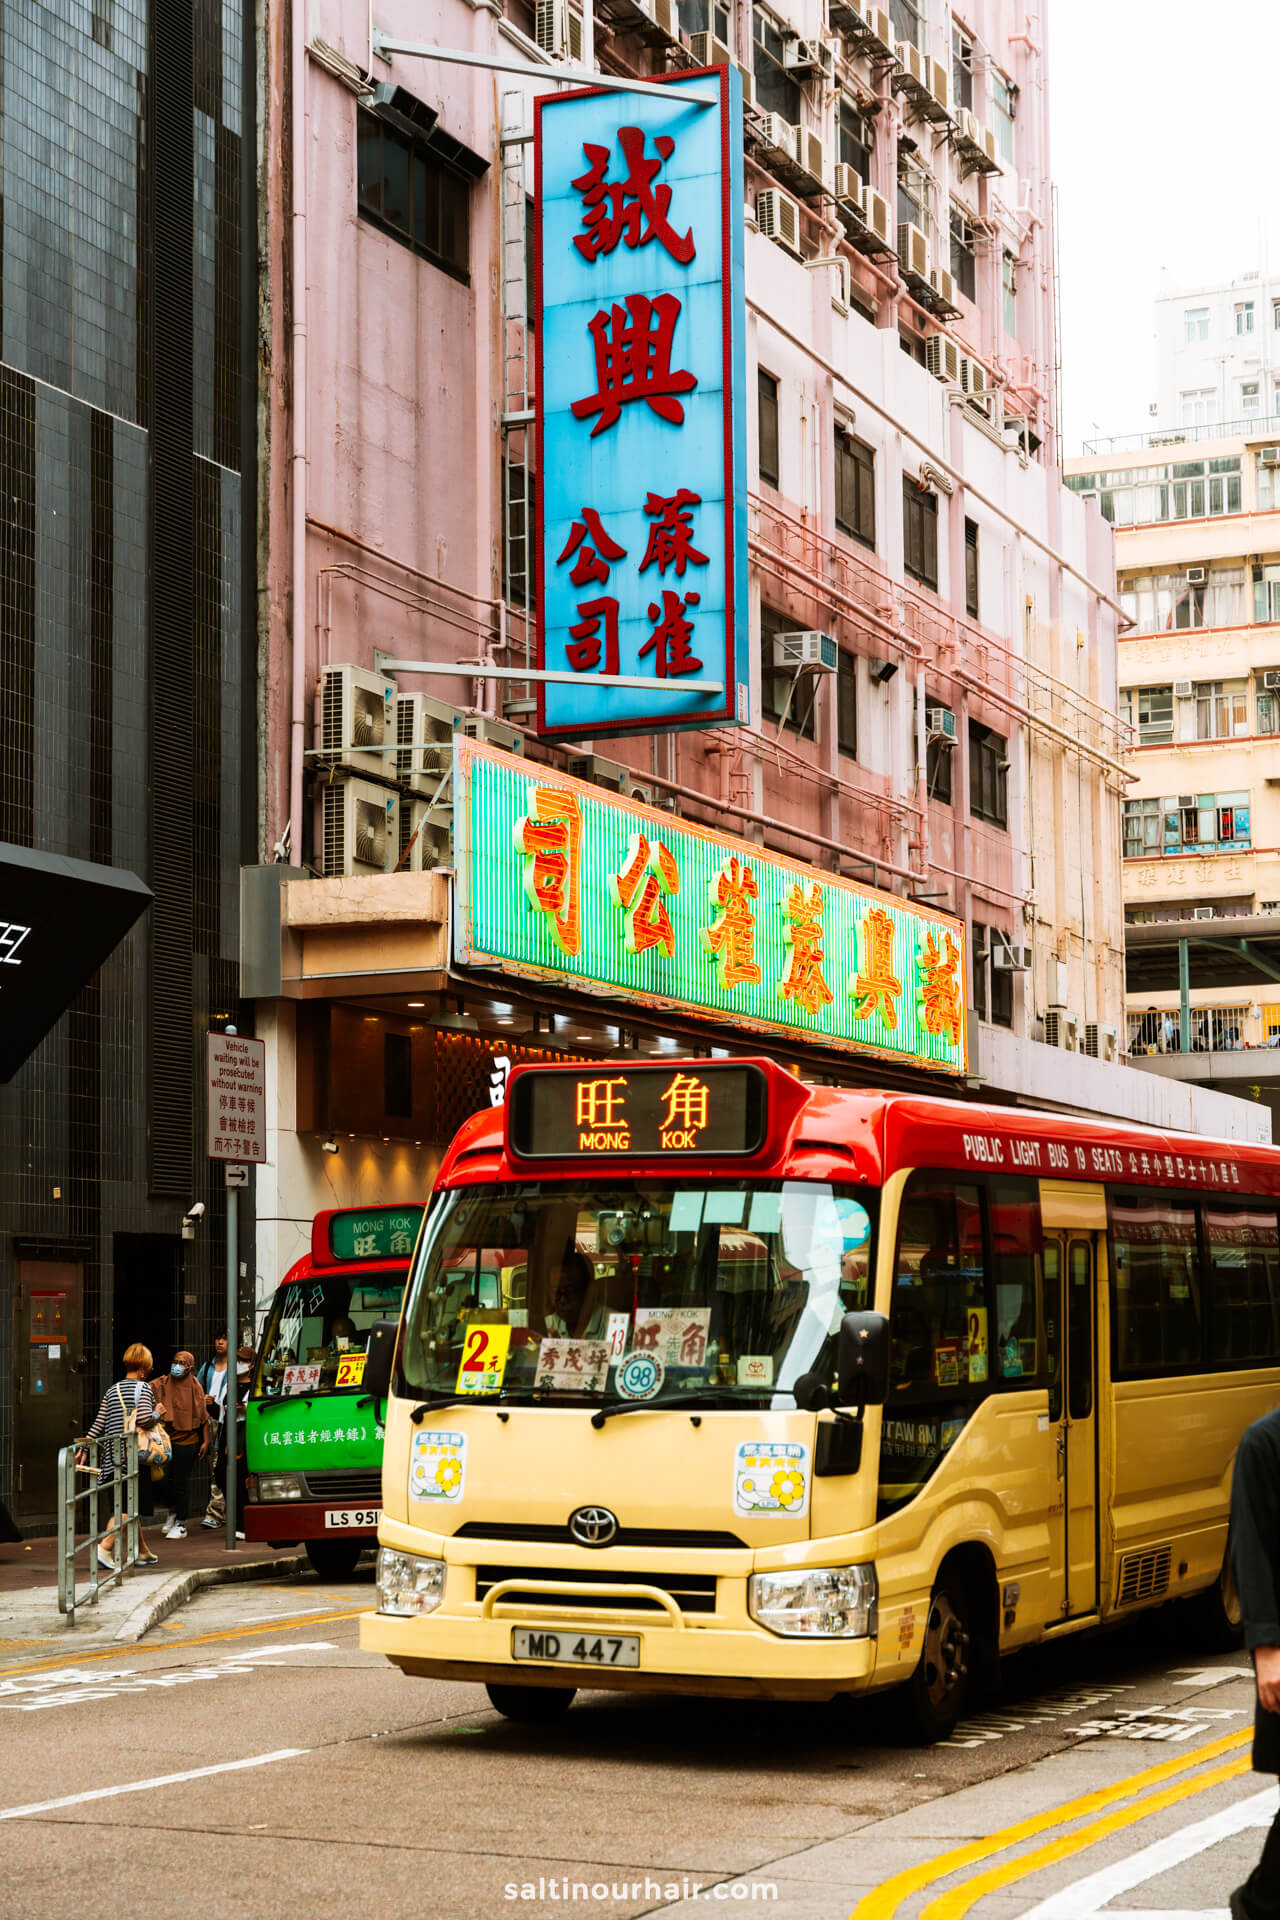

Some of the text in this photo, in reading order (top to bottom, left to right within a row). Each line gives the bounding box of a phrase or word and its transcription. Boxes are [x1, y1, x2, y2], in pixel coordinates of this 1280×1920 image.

[570, 126, 697, 438] 誠興
[556, 507, 628, 677] 公司
[225, 1039, 249, 1054] Vehicle
[214, 1053, 260, 1068] waiting will be
[219, 1066, 255, 1081] prosecuted
[211, 1078, 263, 1096] without warning
[576, 1072, 710, 1130] 旺角
[214, 1137, 261, 1156] 而不予警告
[579, 1129, 697, 1151] MONG KOK
[962, 1134, 1004, 1163] PUBLIC
[1009, 1140, 1042, 1167] LIGHT
[1048, 1143, 1069, 1169] BUS
[1074, 1147, 1087, 1171] 19
[1092, 1148, 1124, 1173] SEATS
[352, 1218, 412, 1233] MONG KOK
[353, 1231, 412, 1257] 旺角
[611, 1329, 625, 1356] 13
[629, 1366, 652, 1387] 98
[330, 1513, 349, 1526] LS
[528, 1632, 623, 1662] MD 447
